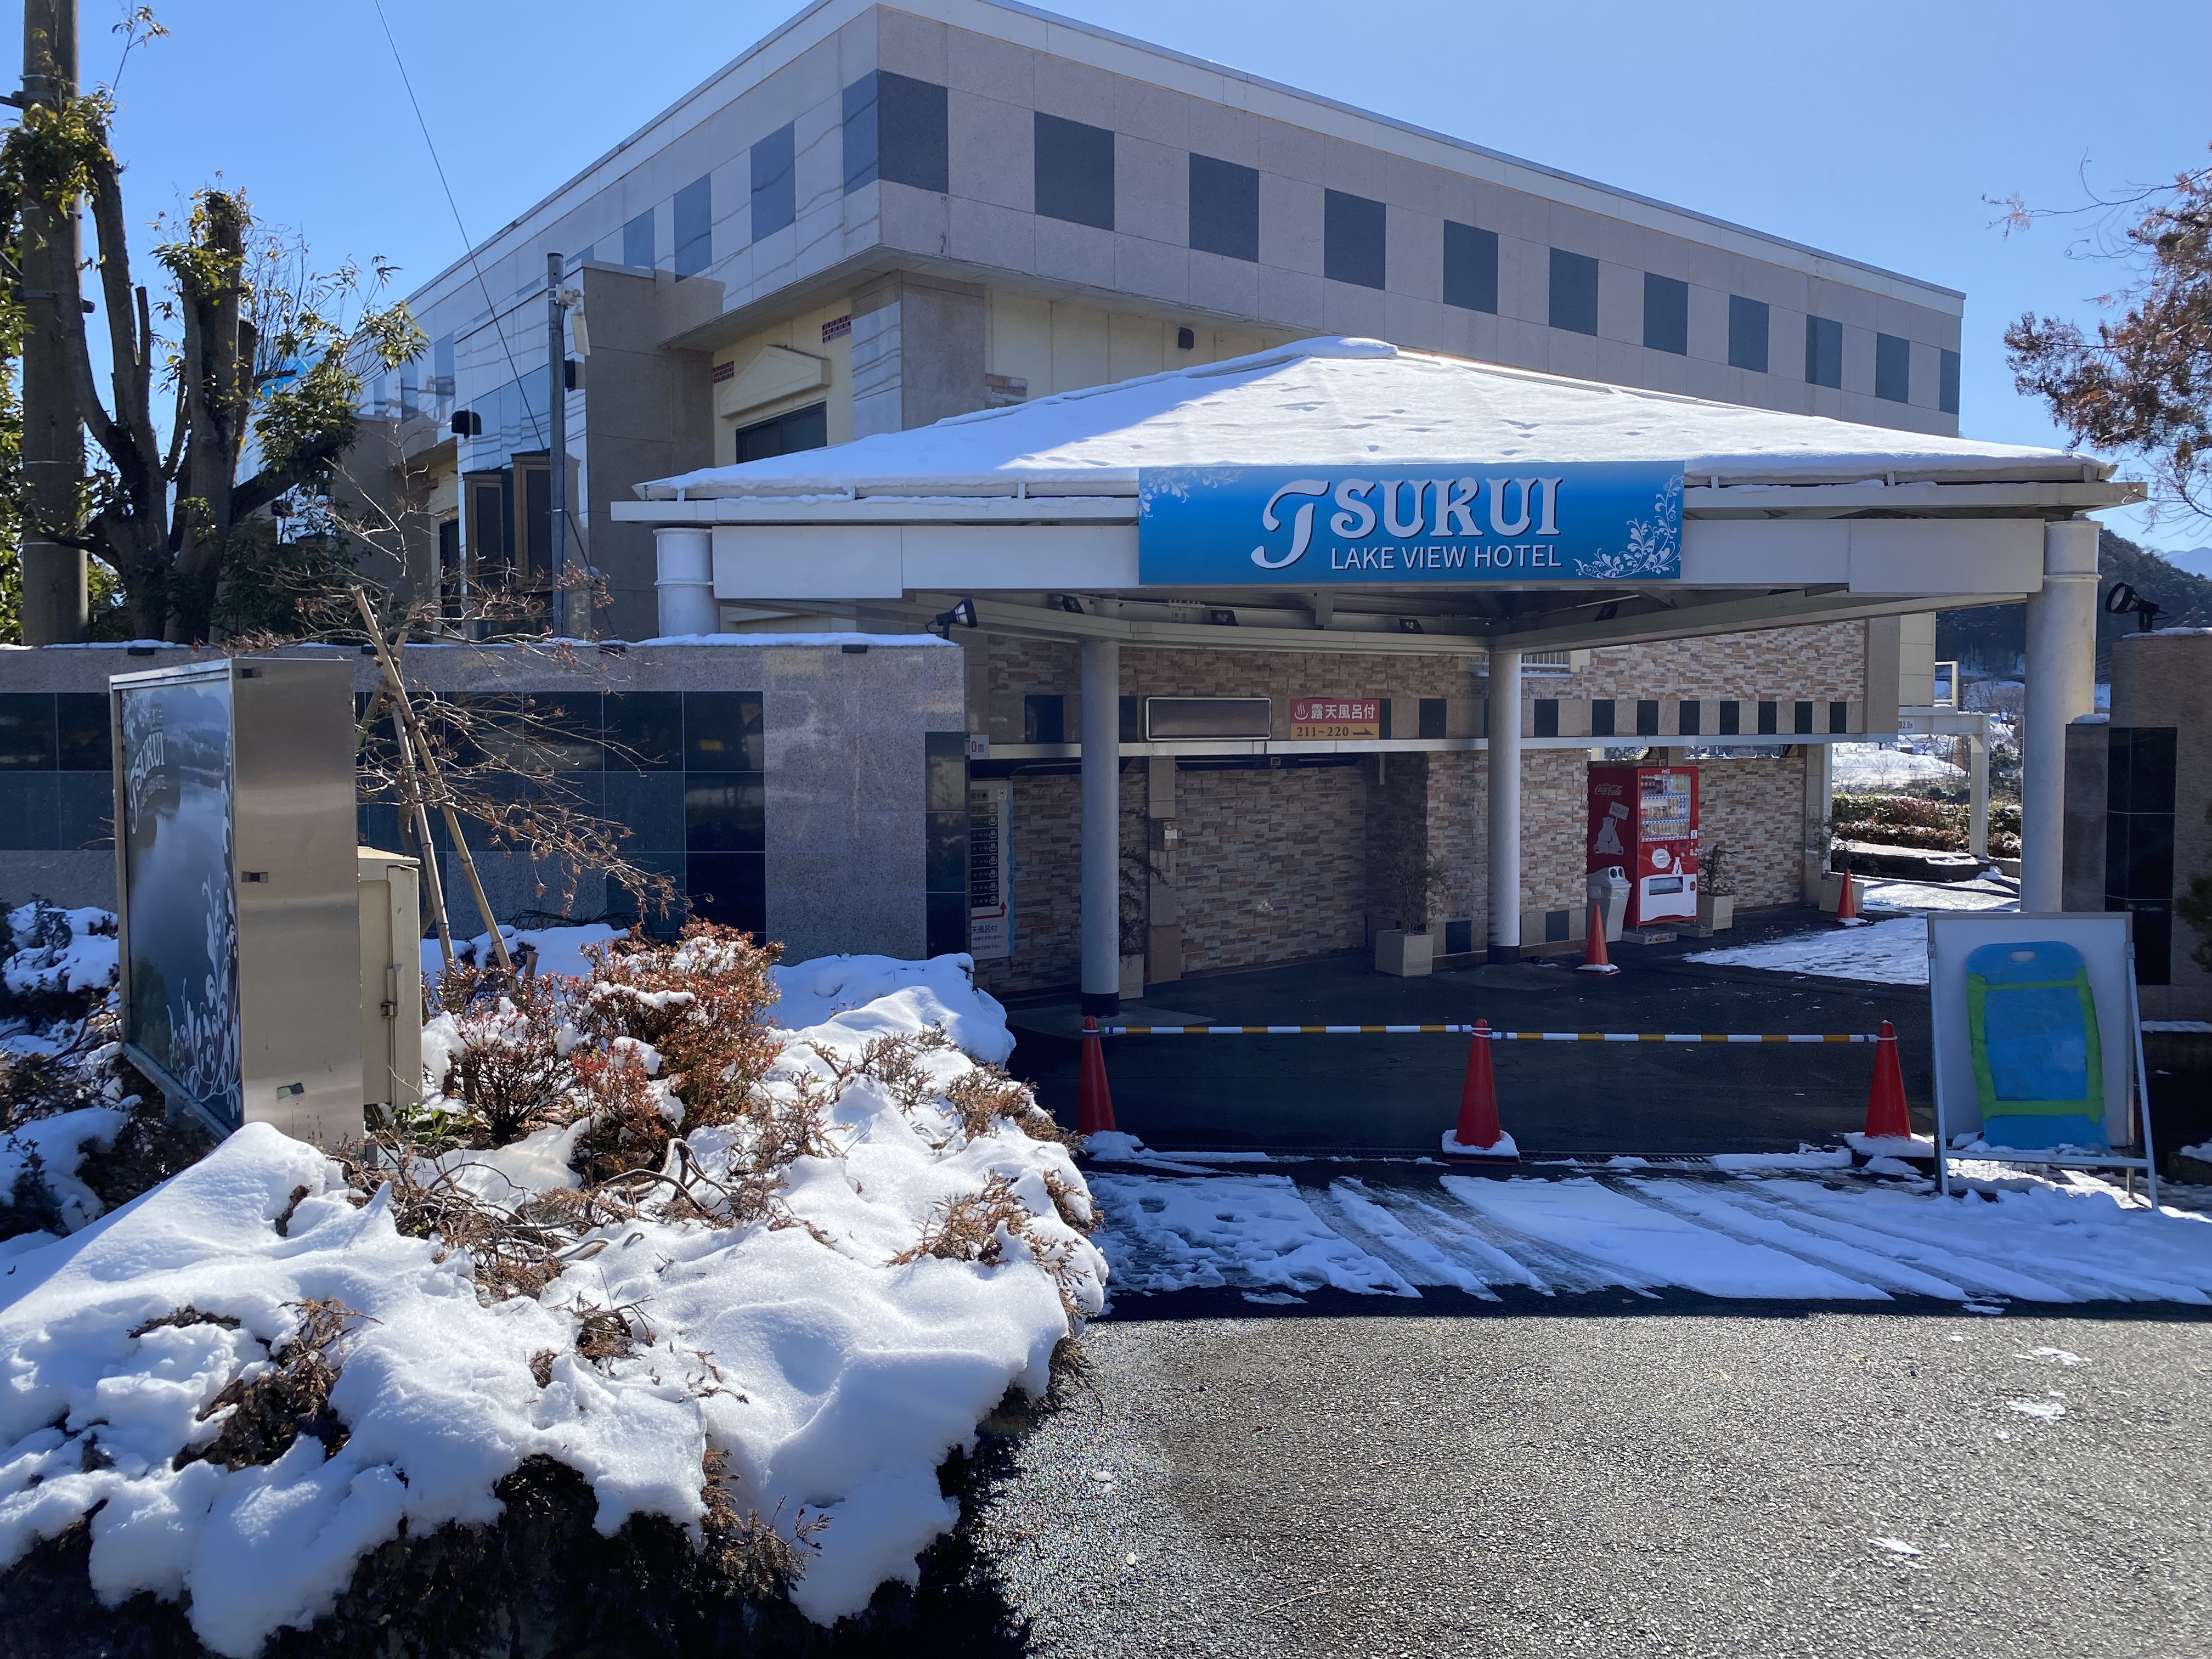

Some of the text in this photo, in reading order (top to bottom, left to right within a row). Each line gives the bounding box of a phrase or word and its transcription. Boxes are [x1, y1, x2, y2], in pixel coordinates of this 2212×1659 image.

[1250, 476, 1564, 570] TSUKUI
[1331, 544, 1562, 570] LAKE VIEW HOTEL
[1311, 704, 1375, 719] 露天風呂付
